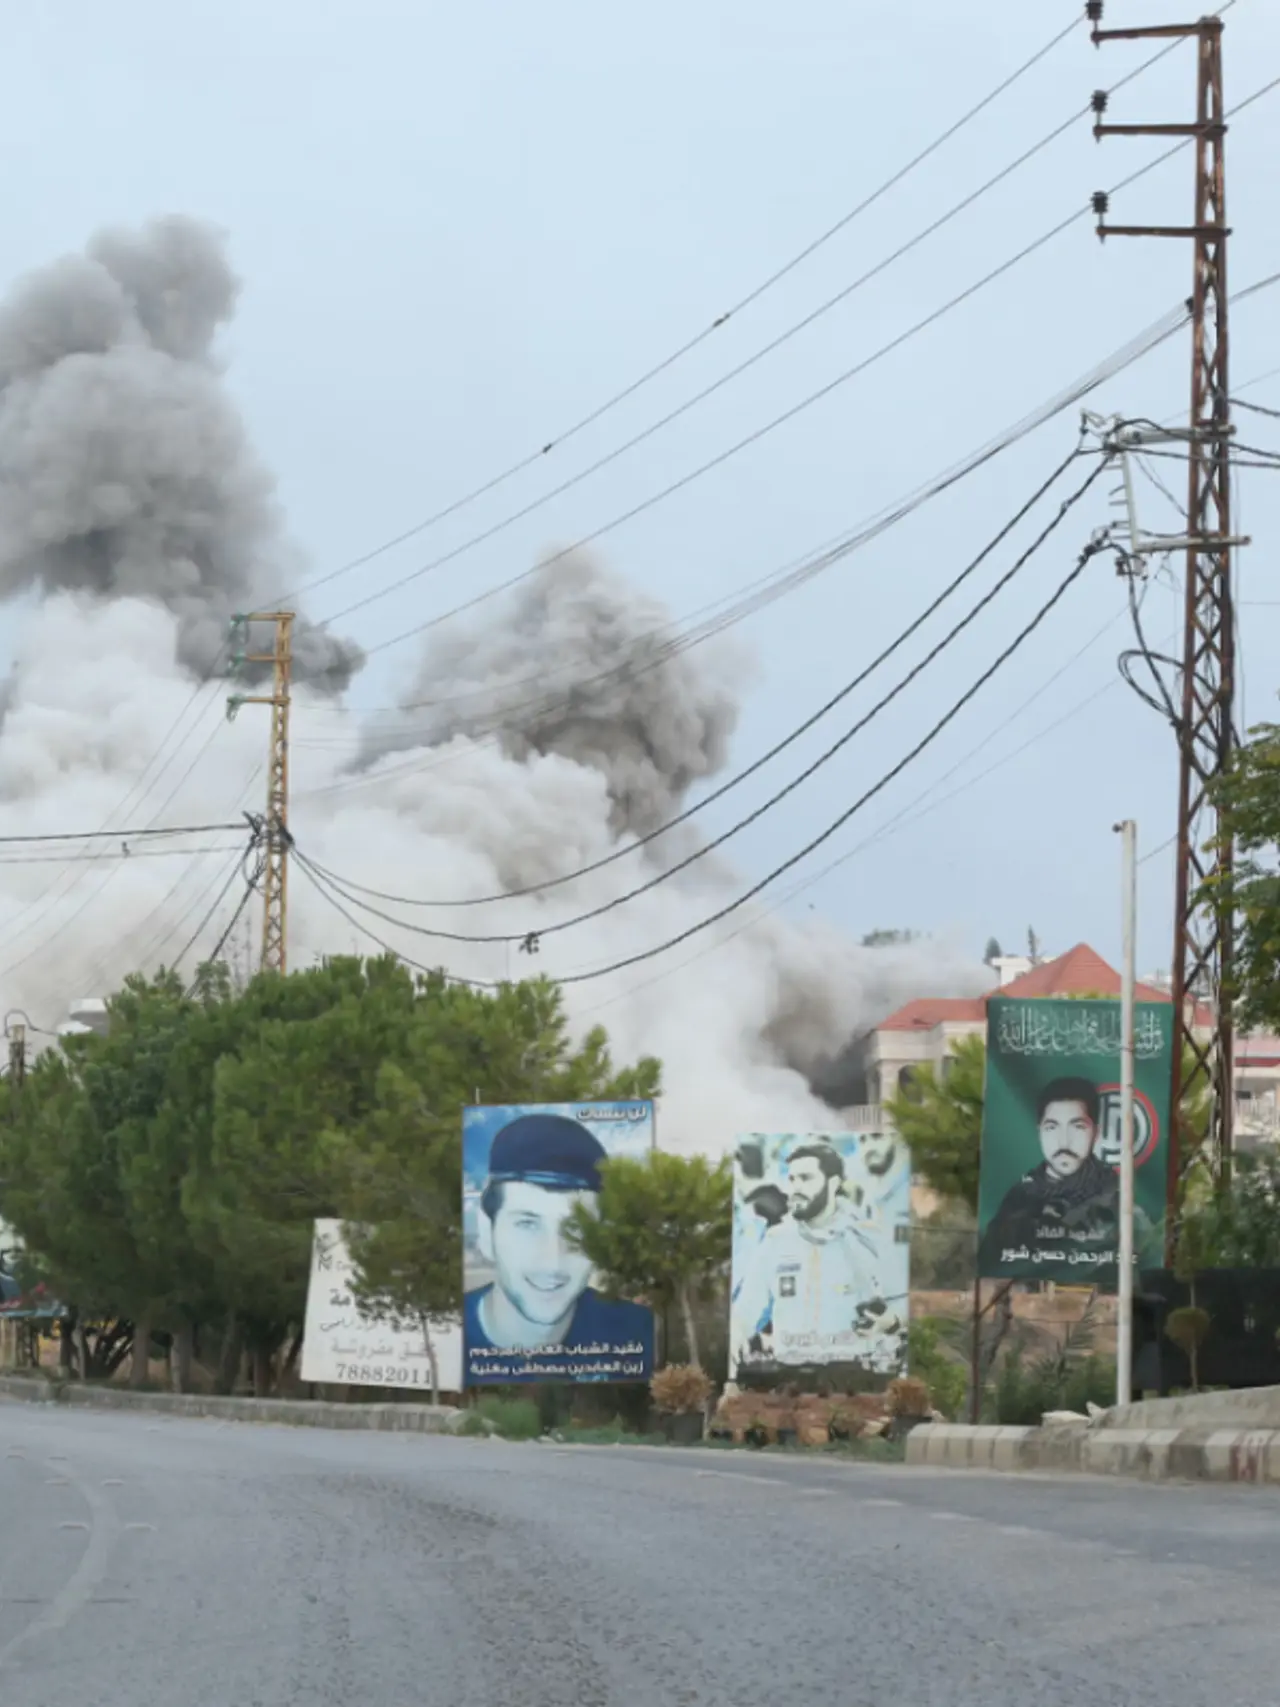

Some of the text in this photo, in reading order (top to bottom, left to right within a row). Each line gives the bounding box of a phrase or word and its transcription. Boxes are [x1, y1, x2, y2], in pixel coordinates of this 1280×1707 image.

[1032, 1247, 1066, 1264] حسين
[1068, 1248, 1114, 1266] الرحمن
[565, 1340, 610, 1356] الشباب
[611, 1340, 644, 1355] فقيد
[568, 1360, 621, 1376] العابدين
[622, 1359, 644, 1375] زين
